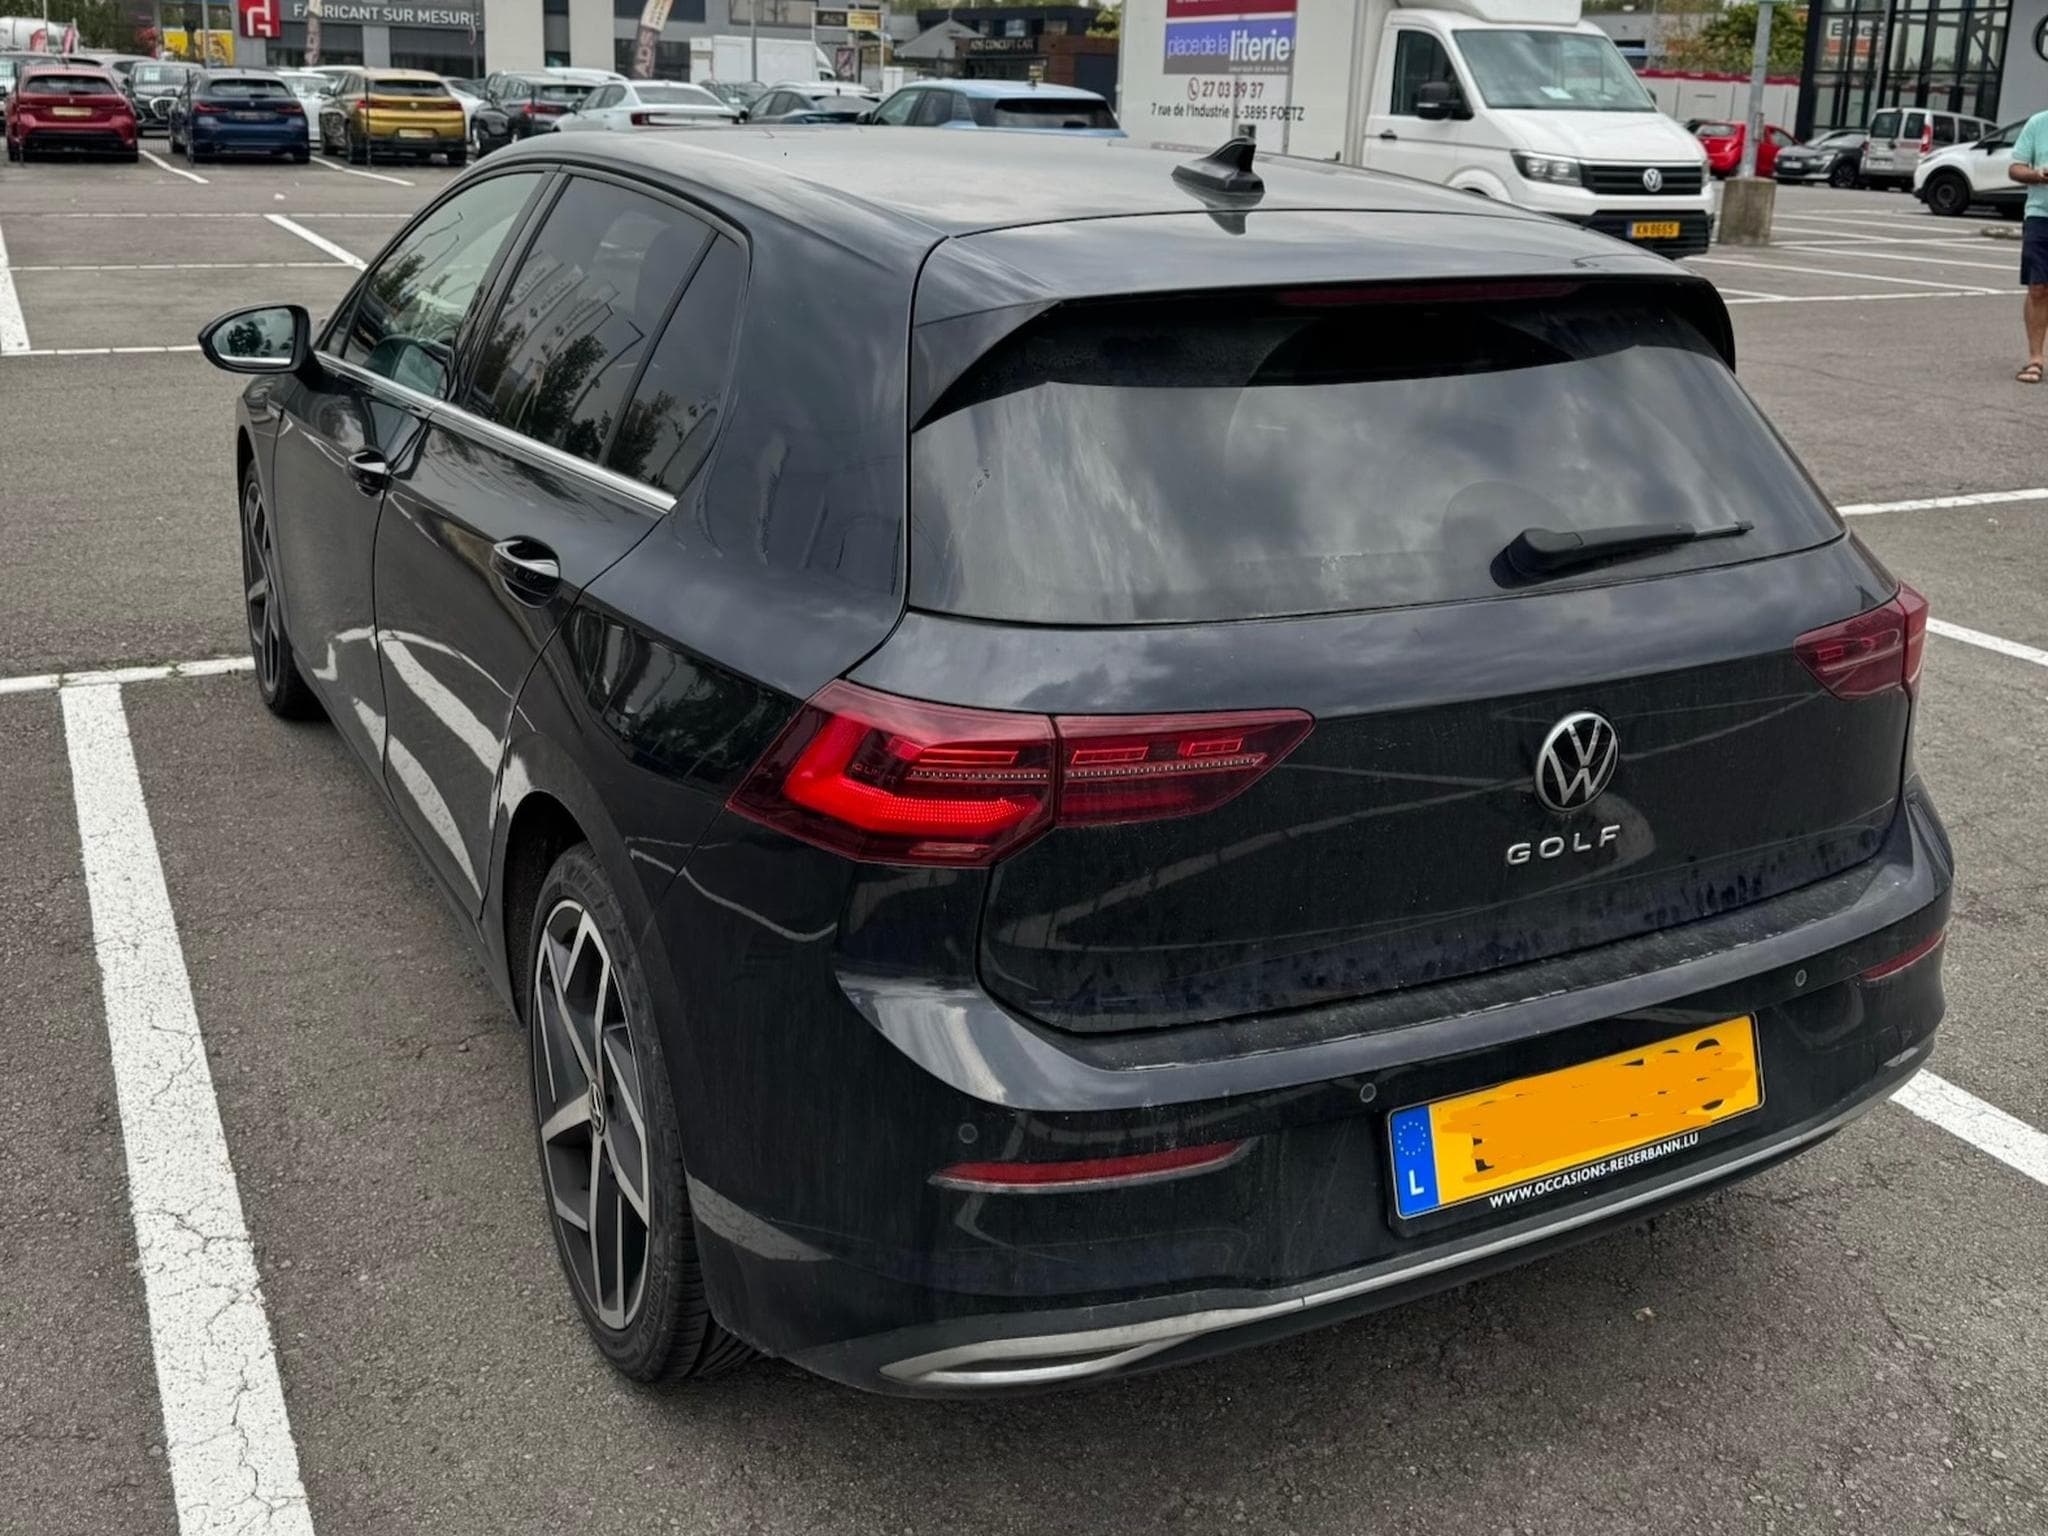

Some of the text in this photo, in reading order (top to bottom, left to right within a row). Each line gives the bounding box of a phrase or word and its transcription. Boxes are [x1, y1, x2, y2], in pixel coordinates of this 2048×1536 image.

[382, 9, 414, 22] SUR
[1167, 29, 1291, 61] place de la literie
[1202, 81, 1216, 98] 27
[1217, 81, 1231, 98] 03
[1250, 82, 1265, 99] 37
[1151, 102, 1158, 116] 7
[1158, 105, 1172, 117] rue
[1173, 103, 1185, 117] de
[1233, 105, 1268, 120] L-3895
[1270, 106, 1305, 121] FOETZ
[1506, 824, 1621, 866] GOLF
[1408, 1168, 1425, 1197] L
[1489, 1131, 1700, 1209] WWW.OCCASIONS-REISERBANN.LU
